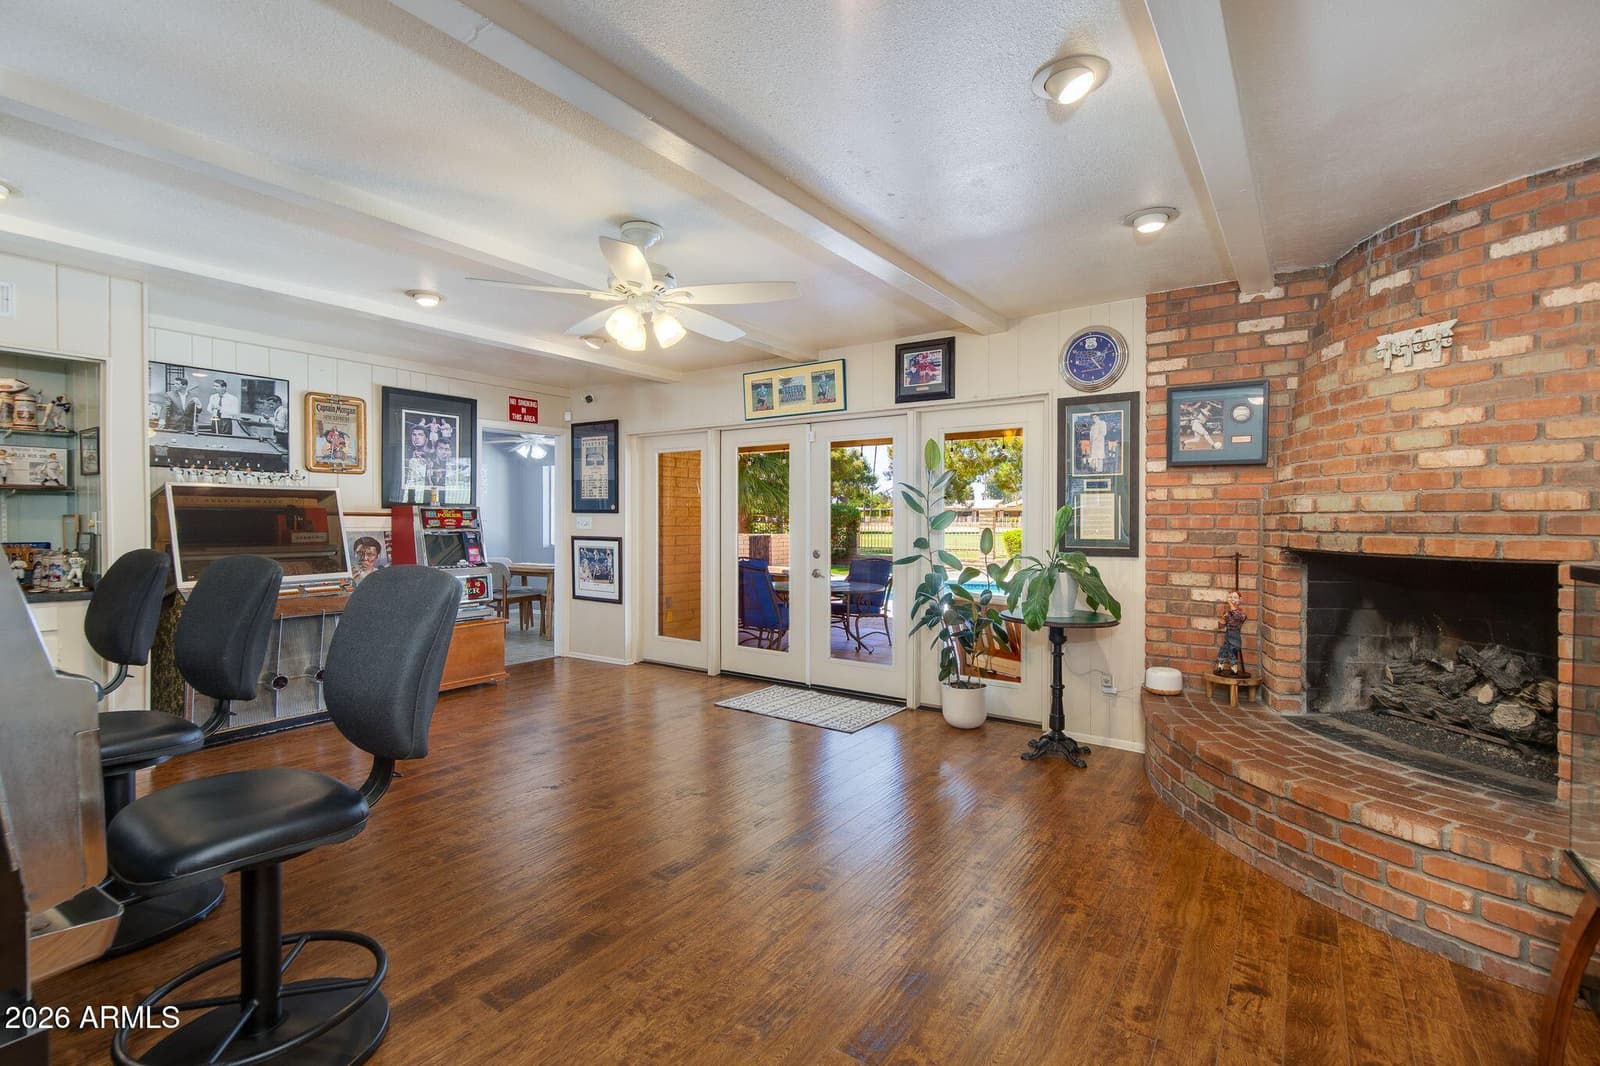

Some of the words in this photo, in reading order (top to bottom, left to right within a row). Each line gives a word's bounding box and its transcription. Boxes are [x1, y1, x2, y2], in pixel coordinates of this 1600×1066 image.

[518, 400, 538, 408] SMOKING
[316, 403, 336, 413] Captain
[336, 405, 356, 416] Morgan
[511, 413, 522, 421] THIS
[523, 415, 536, 423] AREA
